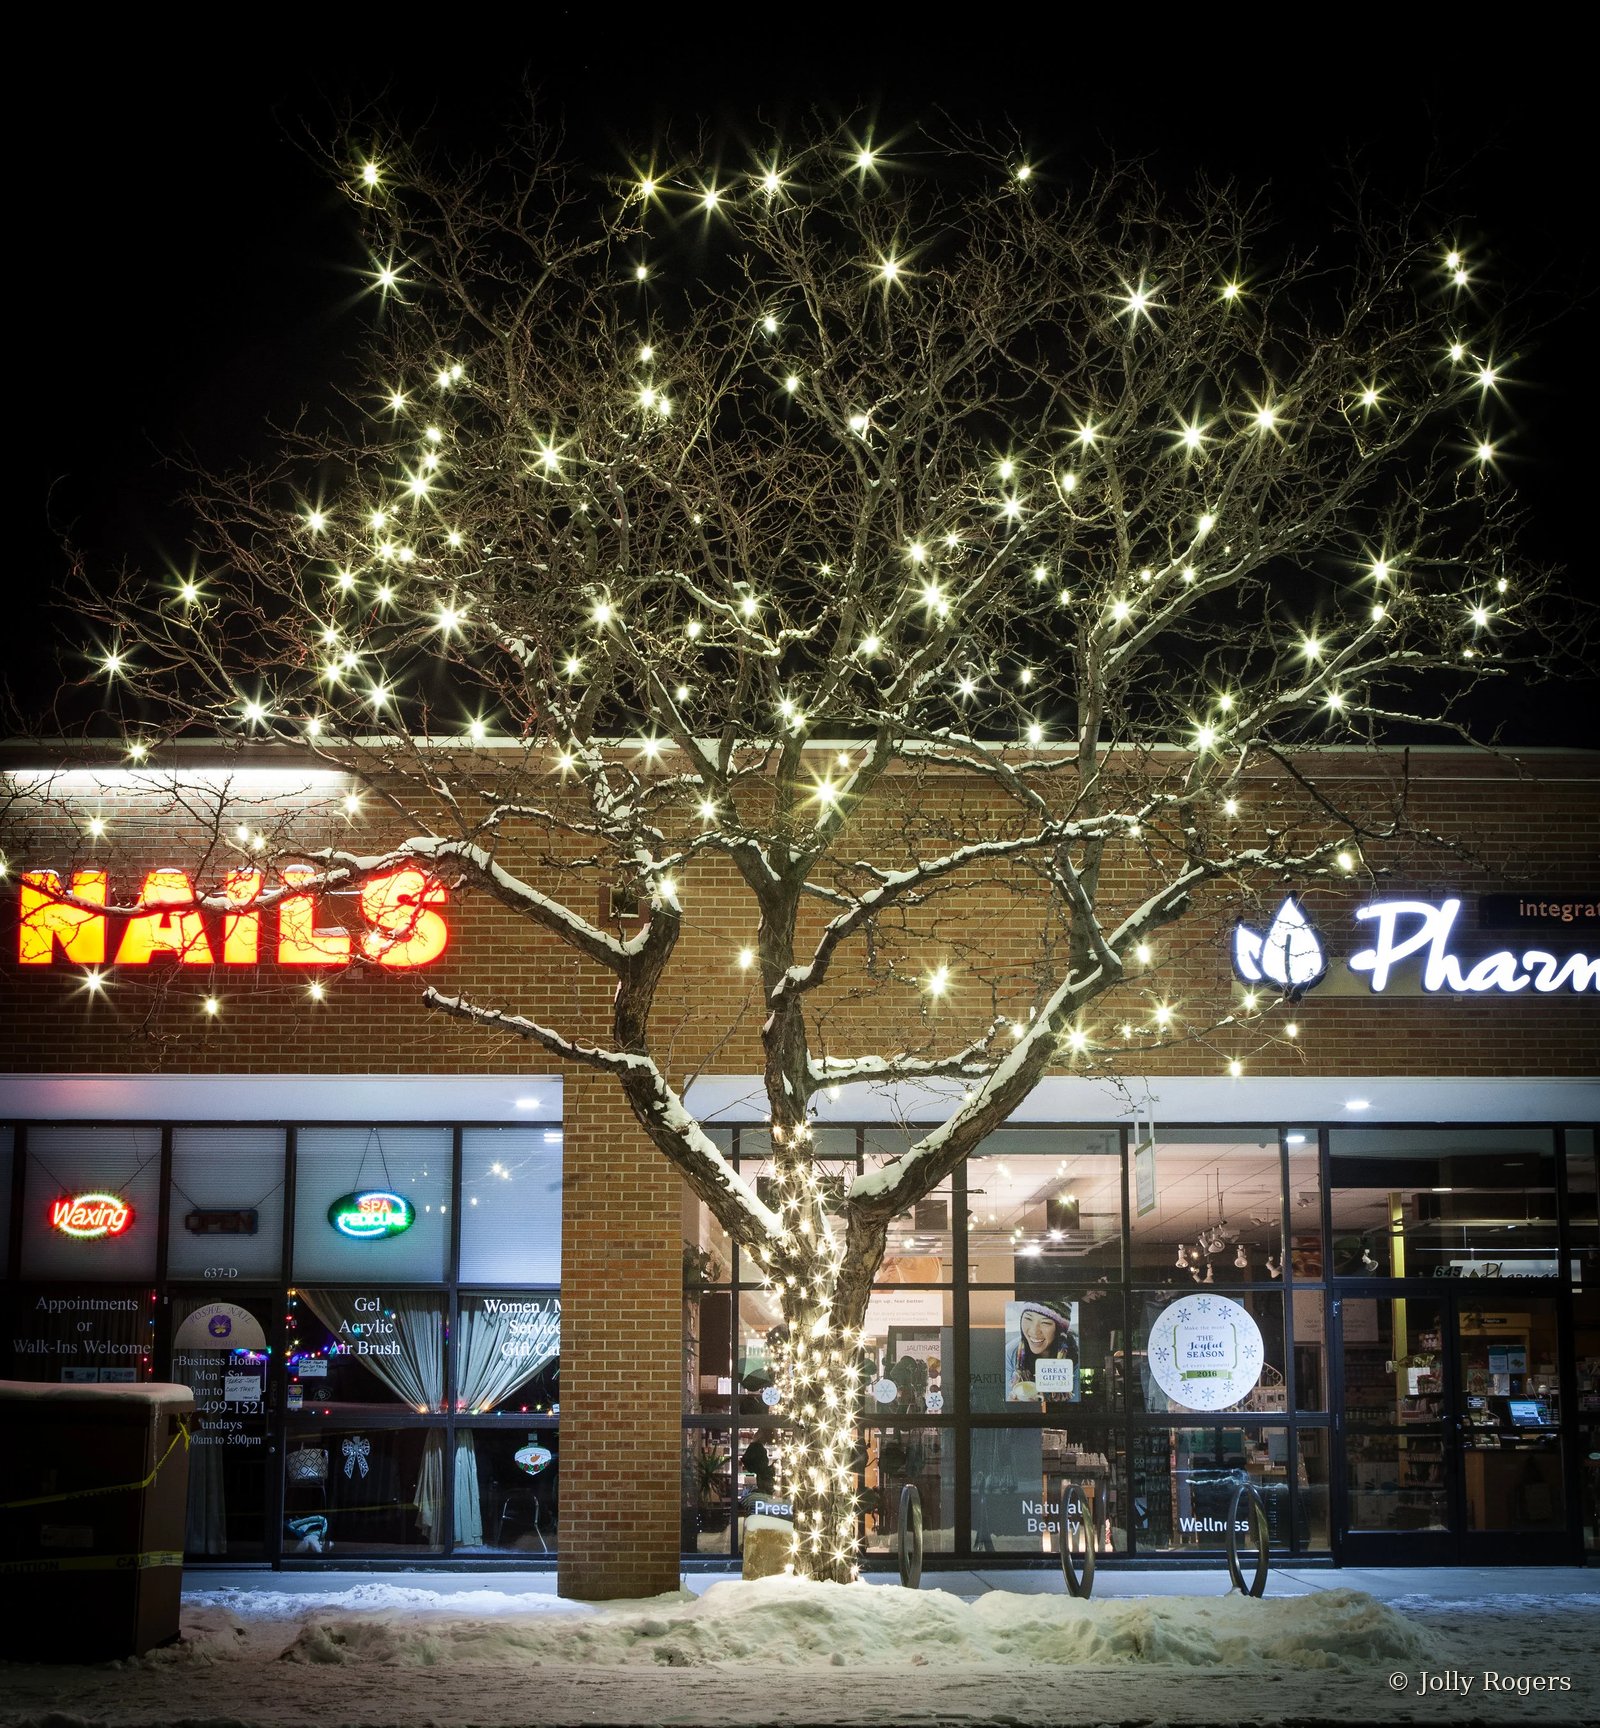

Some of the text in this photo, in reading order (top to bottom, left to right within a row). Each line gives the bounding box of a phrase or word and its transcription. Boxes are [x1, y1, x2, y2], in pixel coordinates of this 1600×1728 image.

[18, 868, 450, 967] NAILS
[360, 1200, 391, 1214] SPA
[54, 1202, 128, 1232] Waxing
[204, 1268, 238, 1278] 637-D
[1435, 1266, 1462, 1276] 645
[36, 1296, 139, 1314] Appointments
[354, 1297, 381, 1312] Gel
[484, 1299, 540, 1314] Women
[76, 1320, 93, 1332] or
[338, 1319, 394, 1337] Acrylic
[12, 1340, 151, 1354] Walk-Ins Welcome
[328, 1340, 402, 1355] Air Brush
[501, 1341, 530, 1357] Gift
[1189, 1341, 1223, 1351] Joyful
[178, 1355, 262, 1367] Business Hours
[194, 1370, 218, 1381] Mon
[1197, 1370, 1217, 1378] 2016
[213, 1386, 223, 1396] to
[198, 1418, 243, 1432] undays
[215, 1435, 225, 1445] to
[227, 1434, 262, 1448] 5:00pm
[1022, 1500, 1083, 1515] Natual
[0, 1561, 60, 1576] AUTION
